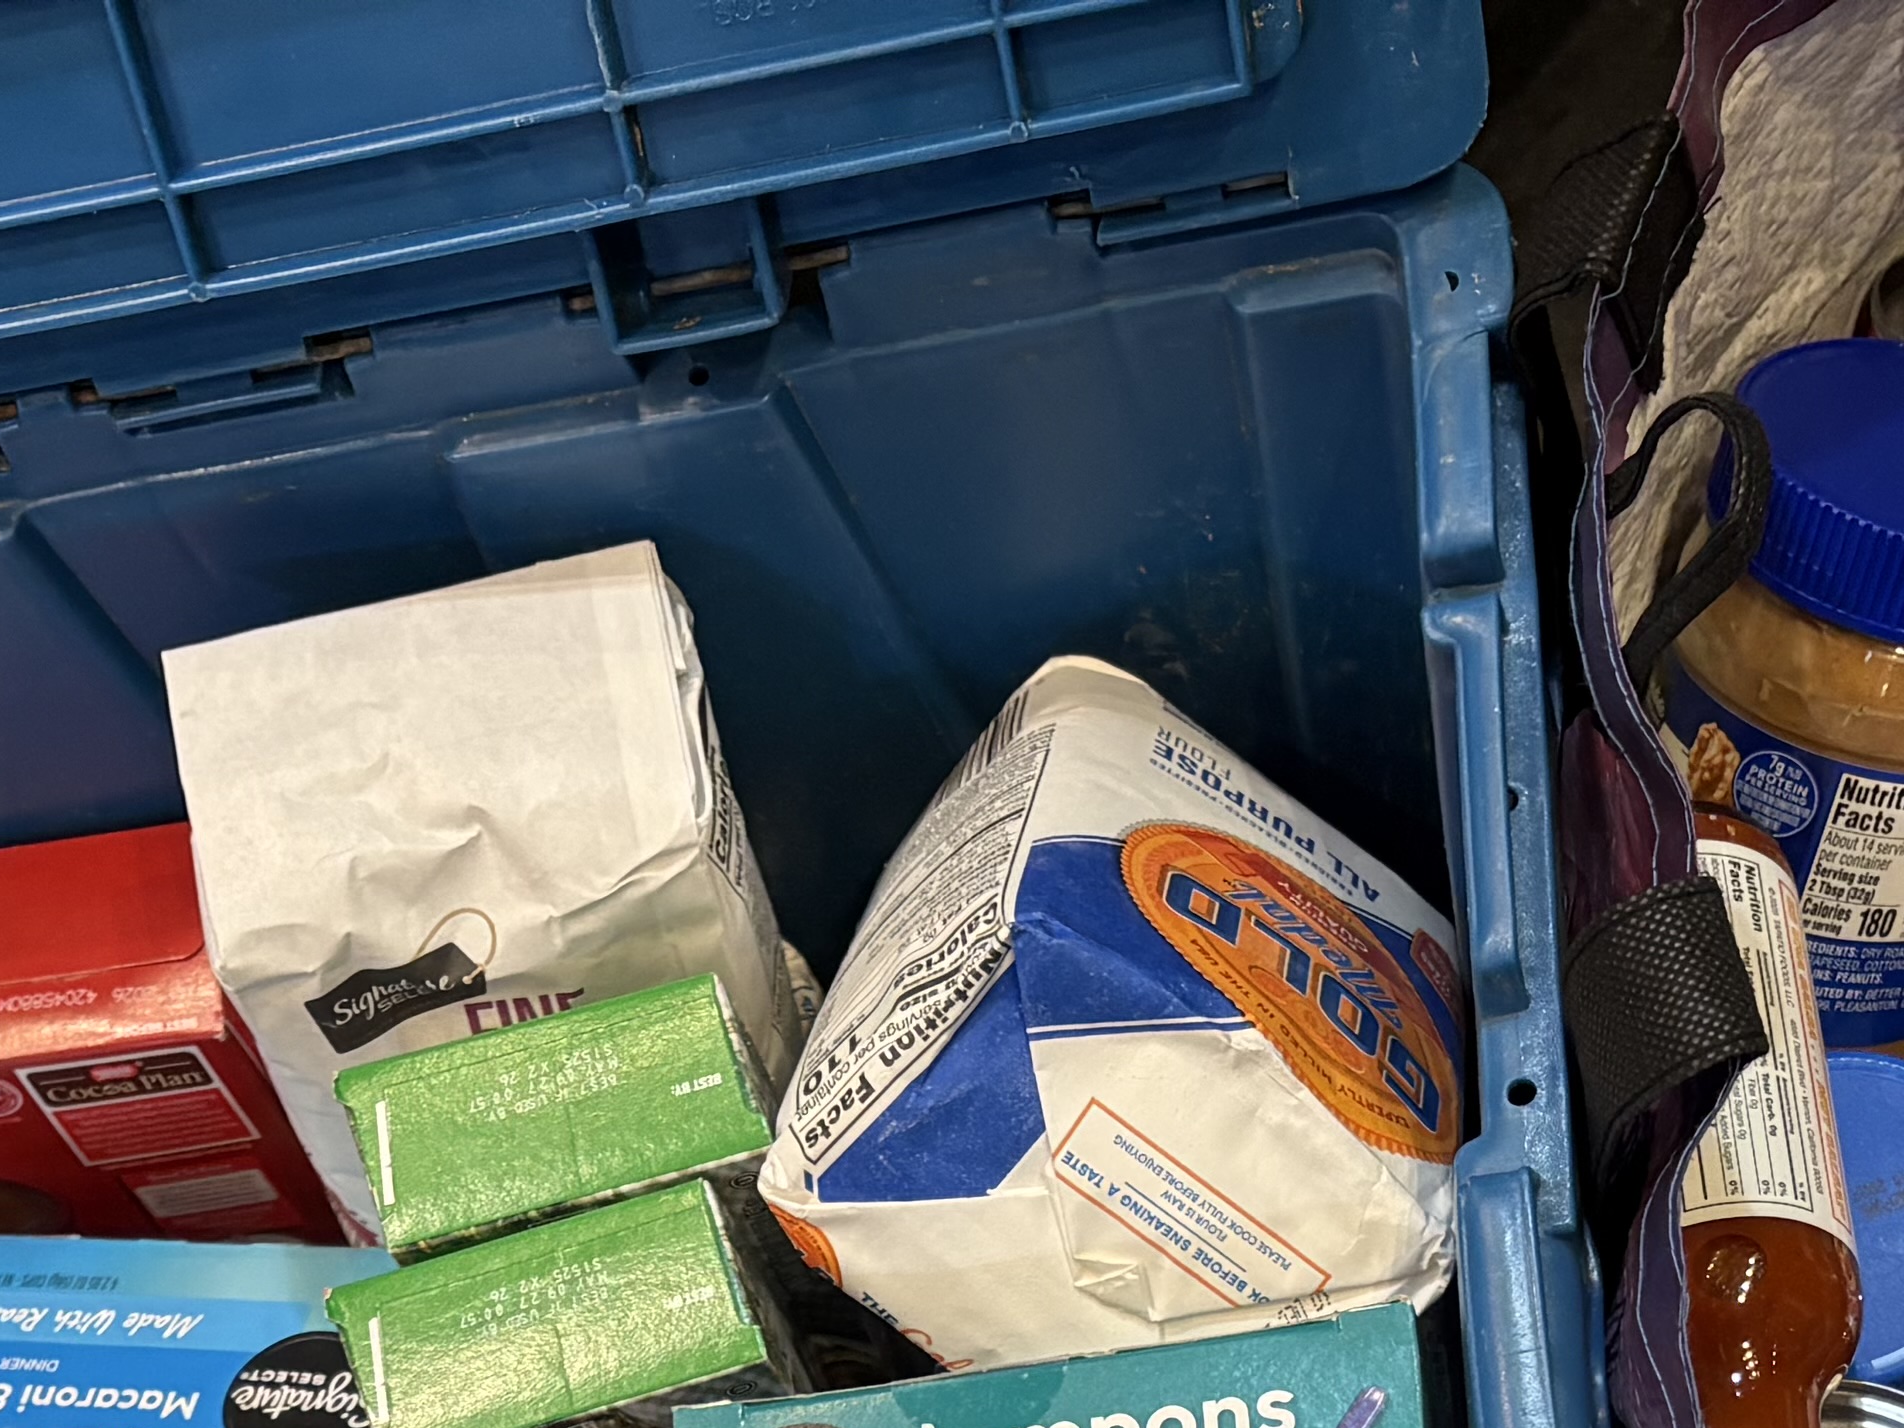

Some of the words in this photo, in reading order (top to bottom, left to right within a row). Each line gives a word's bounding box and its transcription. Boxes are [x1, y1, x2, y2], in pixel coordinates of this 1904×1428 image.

[1158, 725, 1232, 782] FLOUR
[1152, 739, 1316, 856] PURPOSE
[1832, 805, 1896, 835] Facts
[1823, 831, 1859, 851] About
[1862, 839, 1875, 854] 14
[1328, 851, 1380, 902] ALL
[1802, 898, 1853, 921] Calories
[1858, 908, 1898, 938] 180
[878, 947, 1002, 1068] Nutrition
[1162, 870, 1442, 1134] GOLD
[45, 1080, 137, 1106] Cocoa
[139, 1071, 204, 1092] Plan
[805, 1072, 876, 1149] Facts
[1061, 1150, 1105, 1188] TASTE
[1107, 1182, 1121, 1197] A
[1120, 1193, 1192, 1253] SNEAKING
[1191, 1247, 1247, 1293] BEFORE
[54, 1308, 118, 1334] With
[121, 1312, 204, 1340] Made
[16, 1384, 200, 1419] Macaroni
[231, 1370, 372, 1428] Signature
